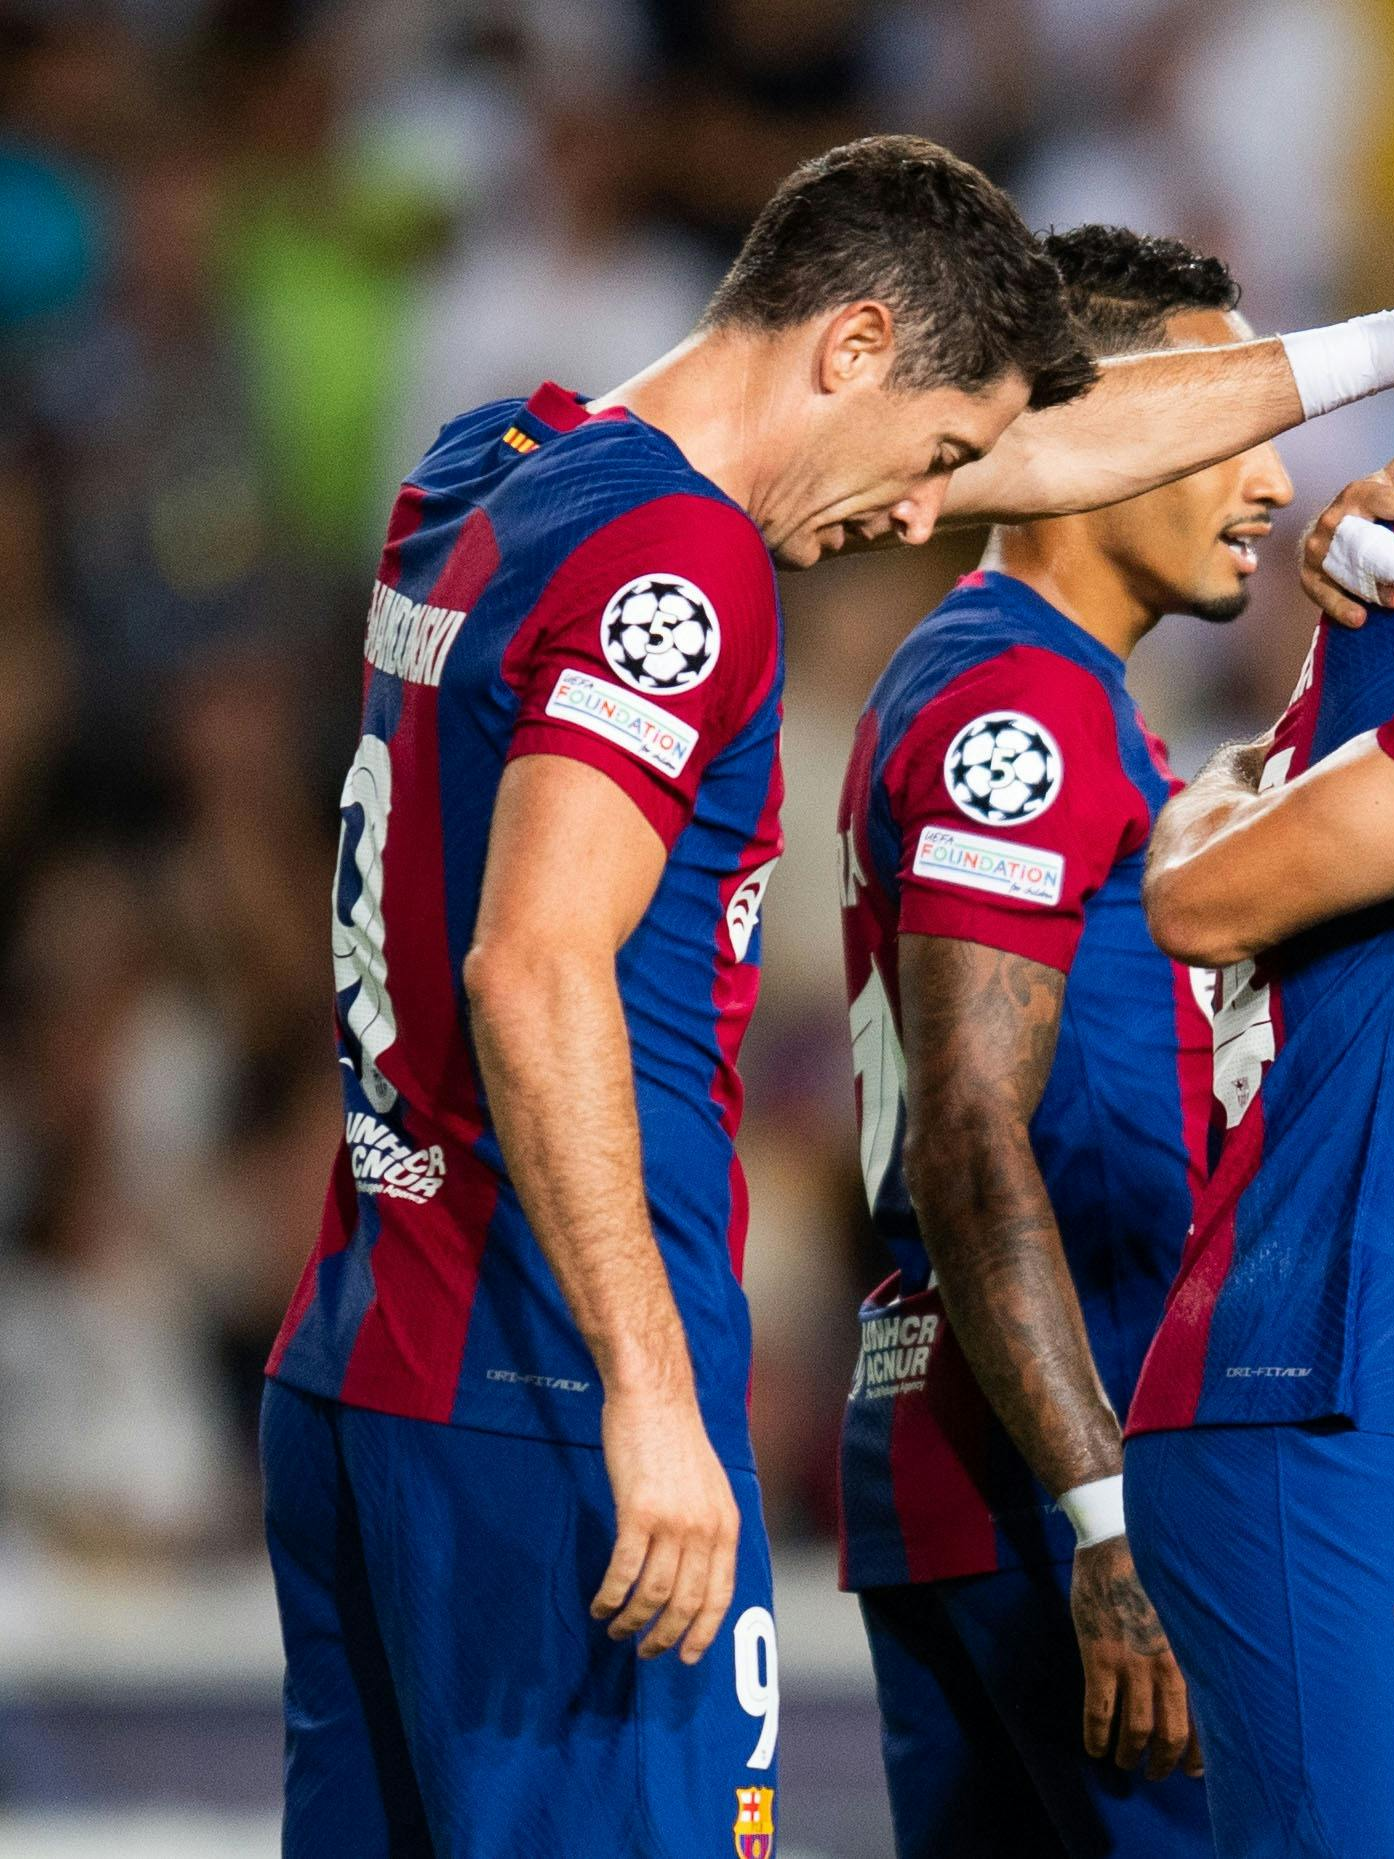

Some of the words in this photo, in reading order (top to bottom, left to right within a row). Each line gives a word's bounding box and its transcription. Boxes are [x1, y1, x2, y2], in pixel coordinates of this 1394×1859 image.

[645, 611, 677, 655] 5
[557, 685, 688, 760] FOUNDATION
[989, 746, 1016, 790] 5
[924, 831, 954, 845] UEFA
[920, 843, 1057, 887] FOUNDATION
[346, 1112, 446, 1176] UNHCR
[352, 1145, 444, 1198] CNUR
[861, 1315, 938, 1353] UNHCR
[866, 1346, 930, 1386] ACNUR
[733, 1605, 779, 1770] 9
